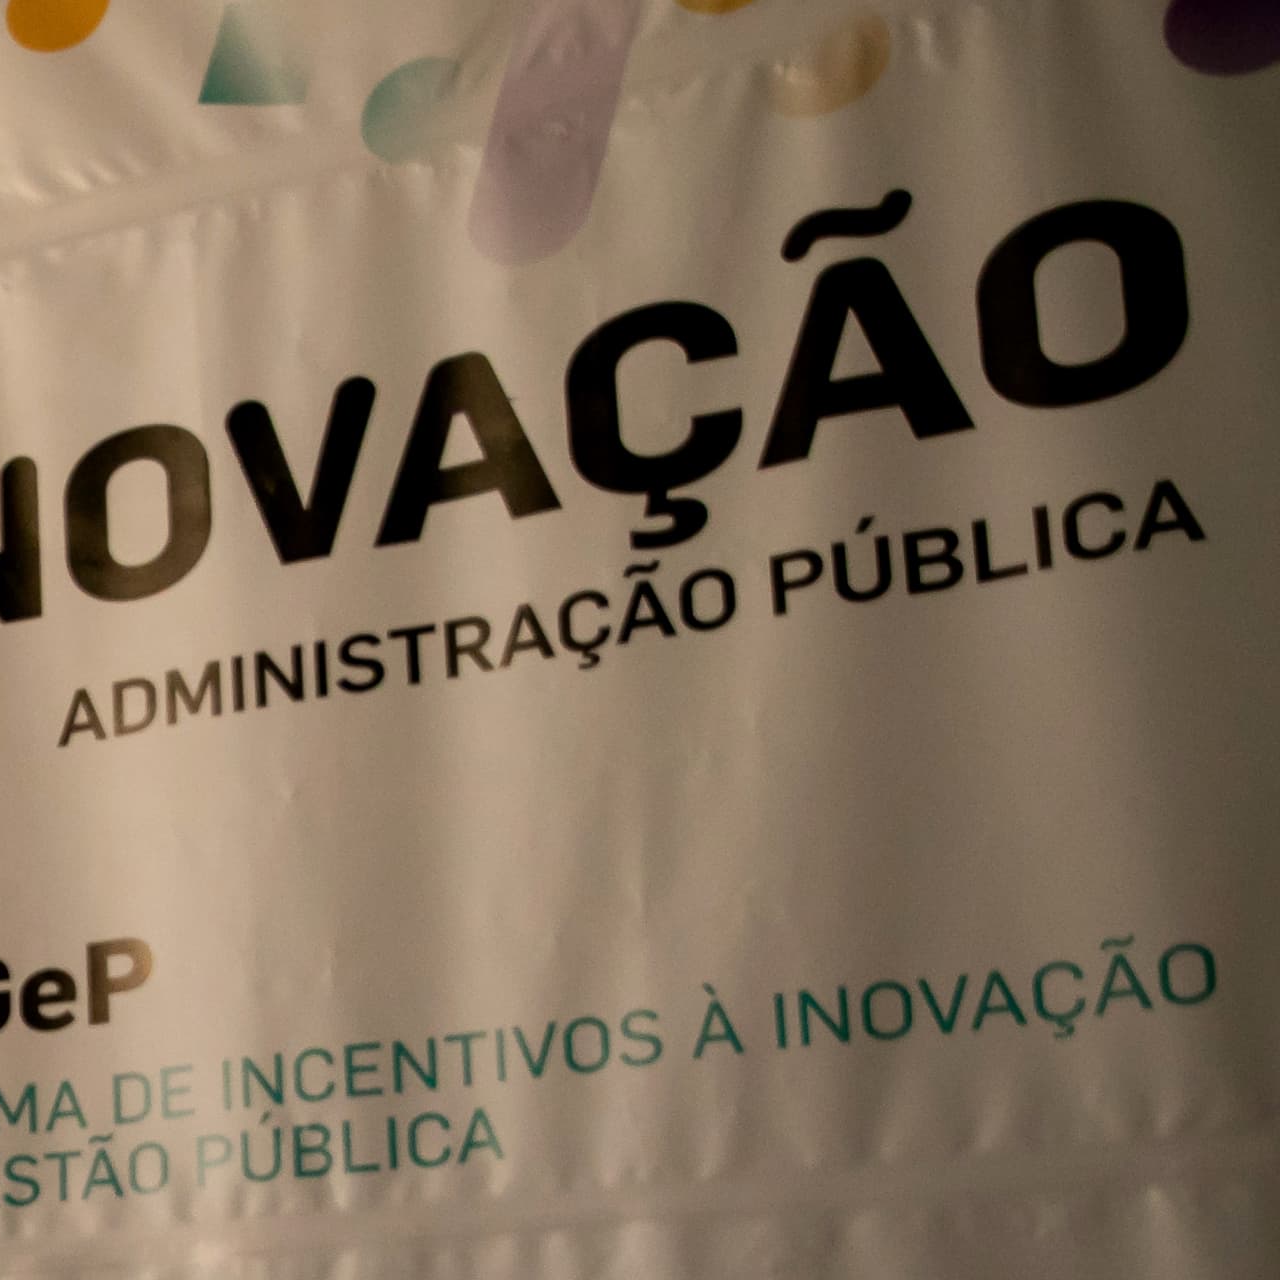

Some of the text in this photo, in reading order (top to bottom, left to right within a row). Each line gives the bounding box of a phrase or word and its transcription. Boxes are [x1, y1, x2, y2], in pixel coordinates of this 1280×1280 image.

[58, 479, 1207, 747] ADMINISTRAÇÃO PÚBLICA
[112, 1062, 195, 1126] DE
[222, 1009, 663, 1112] INCENTIVOS
[692, 982, 745, 1060] À
[773, 935, 1219, 1050] INOVAÇÃO
[196, 1107, 505, 1188] PÚBLICA
